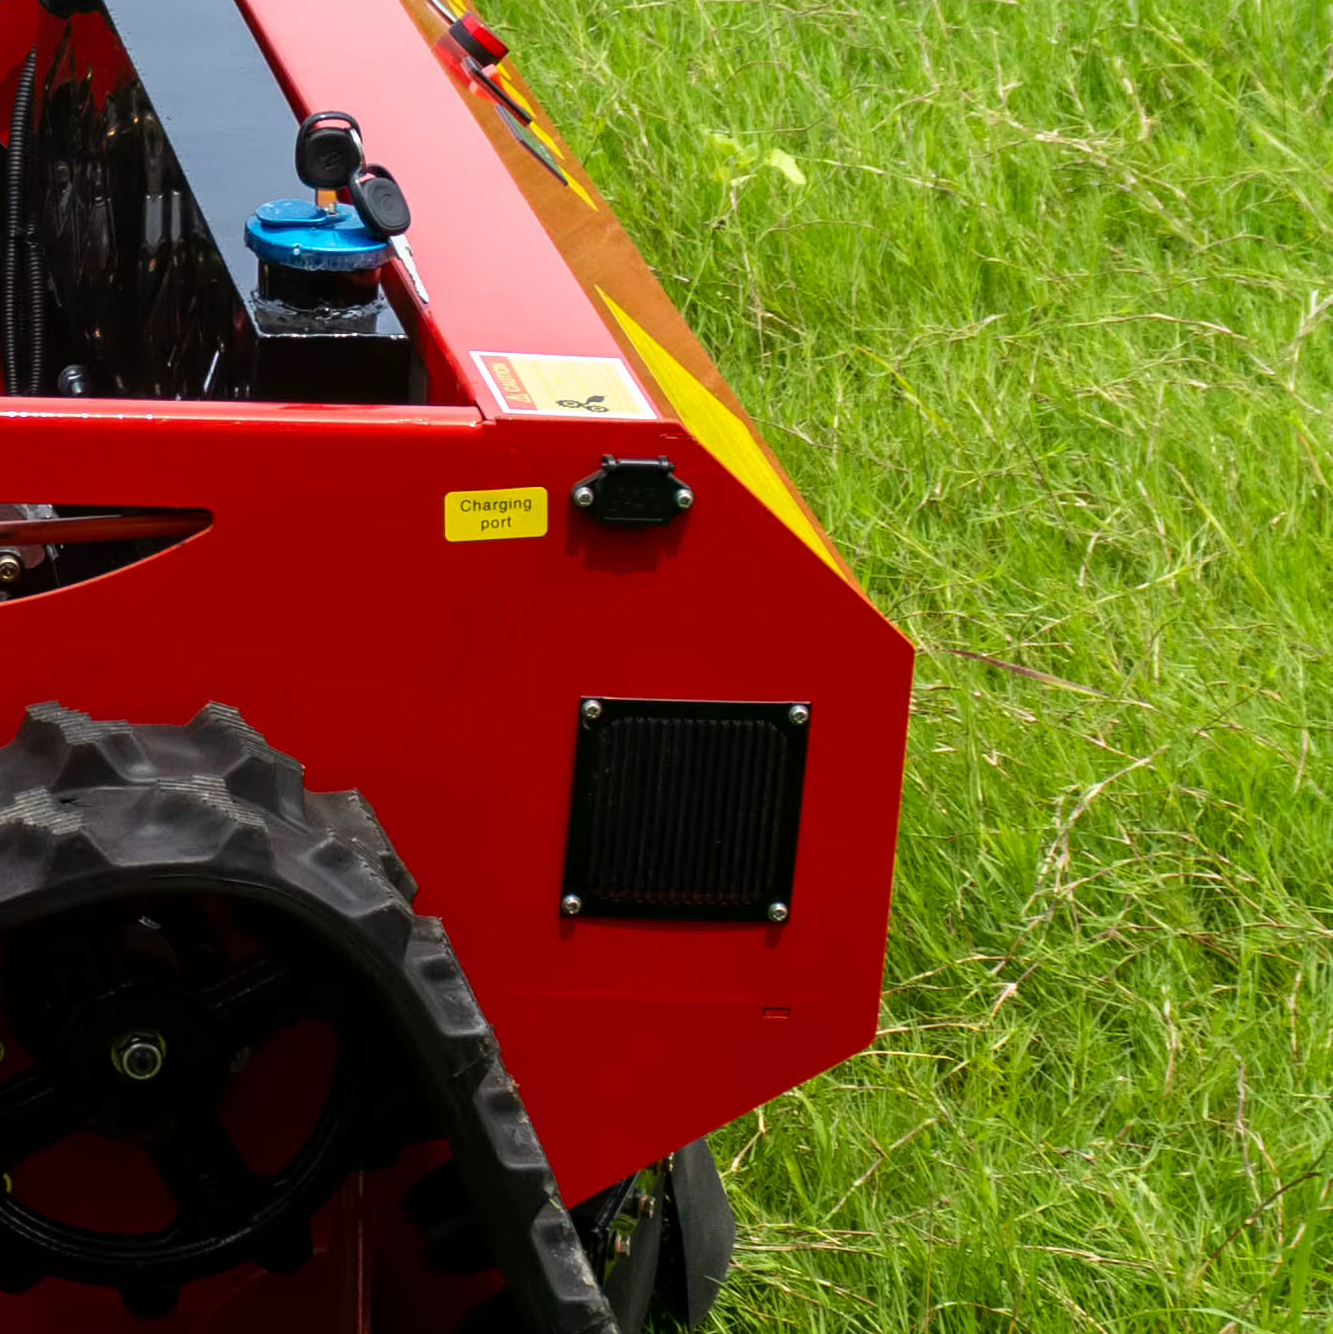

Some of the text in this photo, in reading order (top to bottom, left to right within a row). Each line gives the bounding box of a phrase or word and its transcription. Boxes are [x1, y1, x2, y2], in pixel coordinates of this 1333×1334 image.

[490, 362, 522, 394] CAUTION
[460, 498, 532, 513] Charging
[480, 516, 512, 532] port
